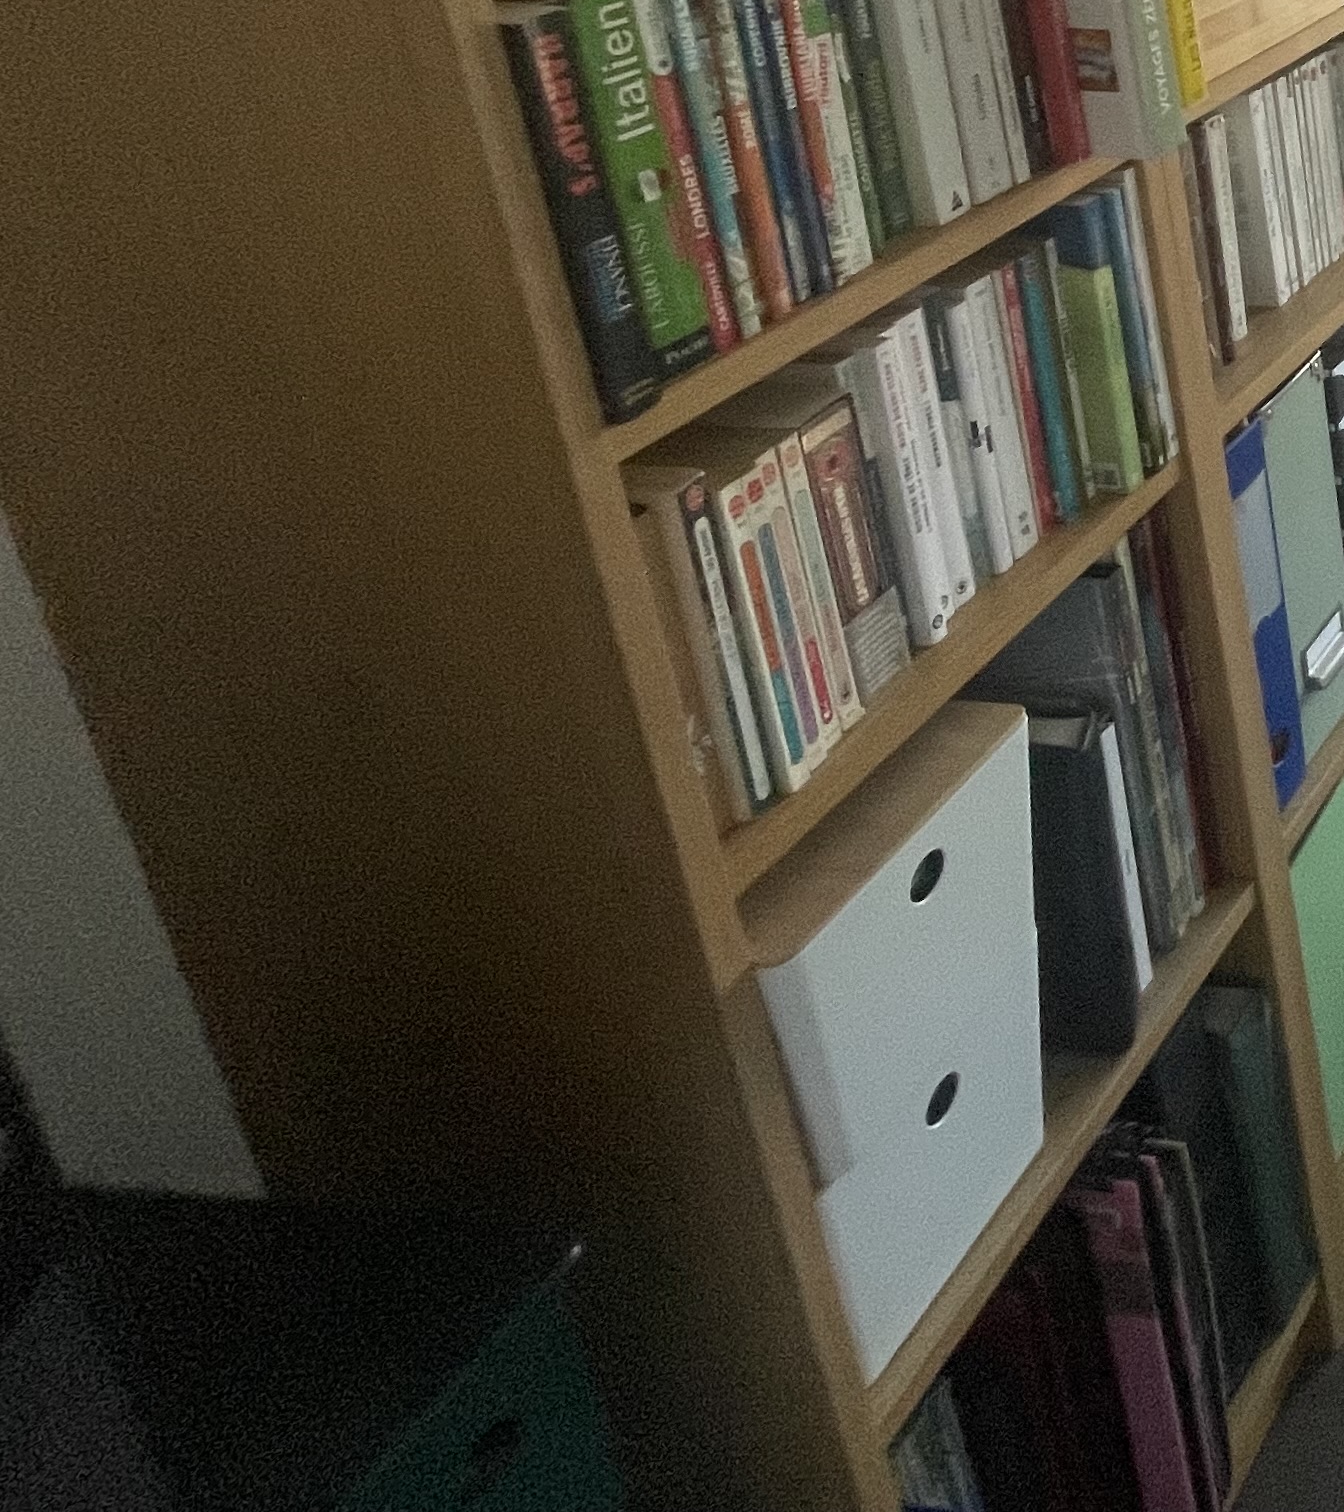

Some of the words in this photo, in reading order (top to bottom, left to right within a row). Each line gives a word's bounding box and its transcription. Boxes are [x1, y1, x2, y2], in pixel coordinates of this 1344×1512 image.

[599, 0, 656, 142] Italien
[770, 19, 798, 111] DUBROVNIK
[1148, 28, 1171, 116] VOYAGES
[678, 153, 711, 240] LONDRES
[626, 222, 671, 330] LAROUSSE
